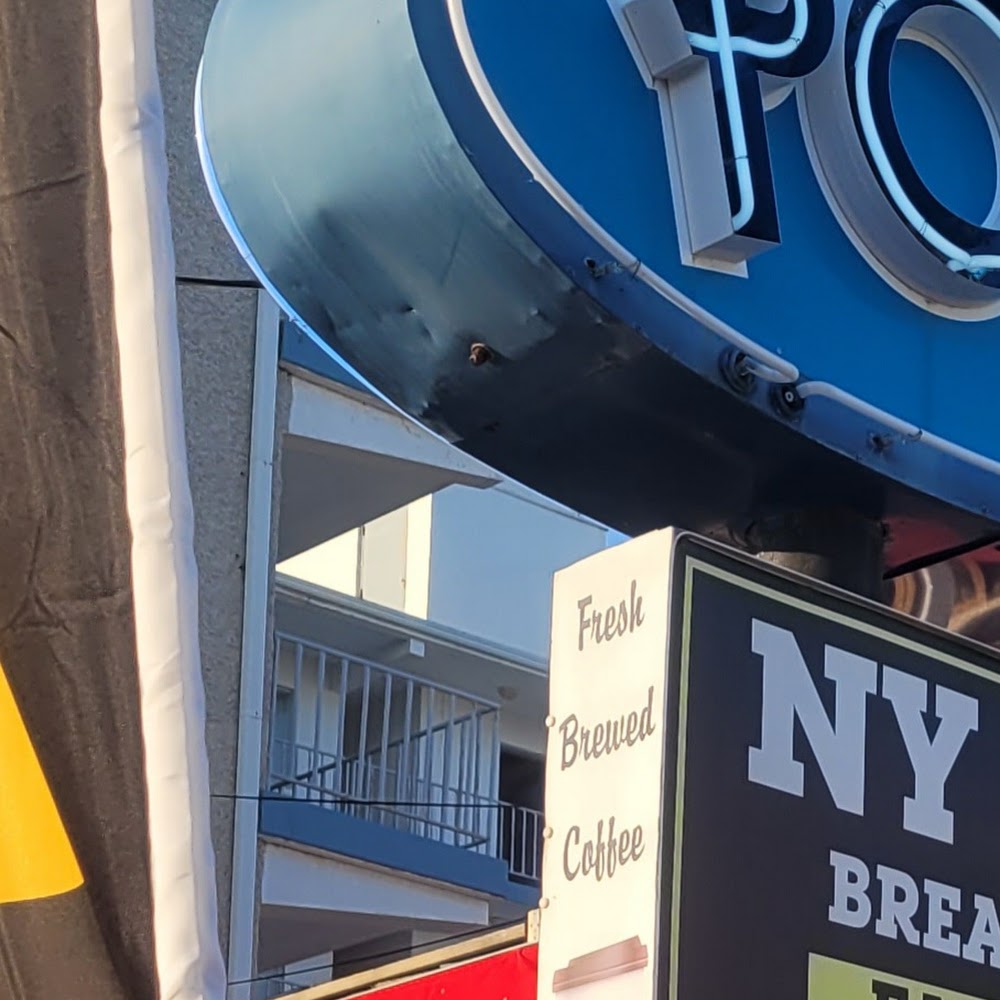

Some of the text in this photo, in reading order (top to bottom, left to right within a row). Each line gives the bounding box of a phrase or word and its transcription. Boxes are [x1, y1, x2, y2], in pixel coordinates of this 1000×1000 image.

[577, 579, 646, 652] Fresh
[558, 686, 657, 772] Brewed
[747, 617, 979, 846] NY
[562, 815, 646, 883] Coffee
